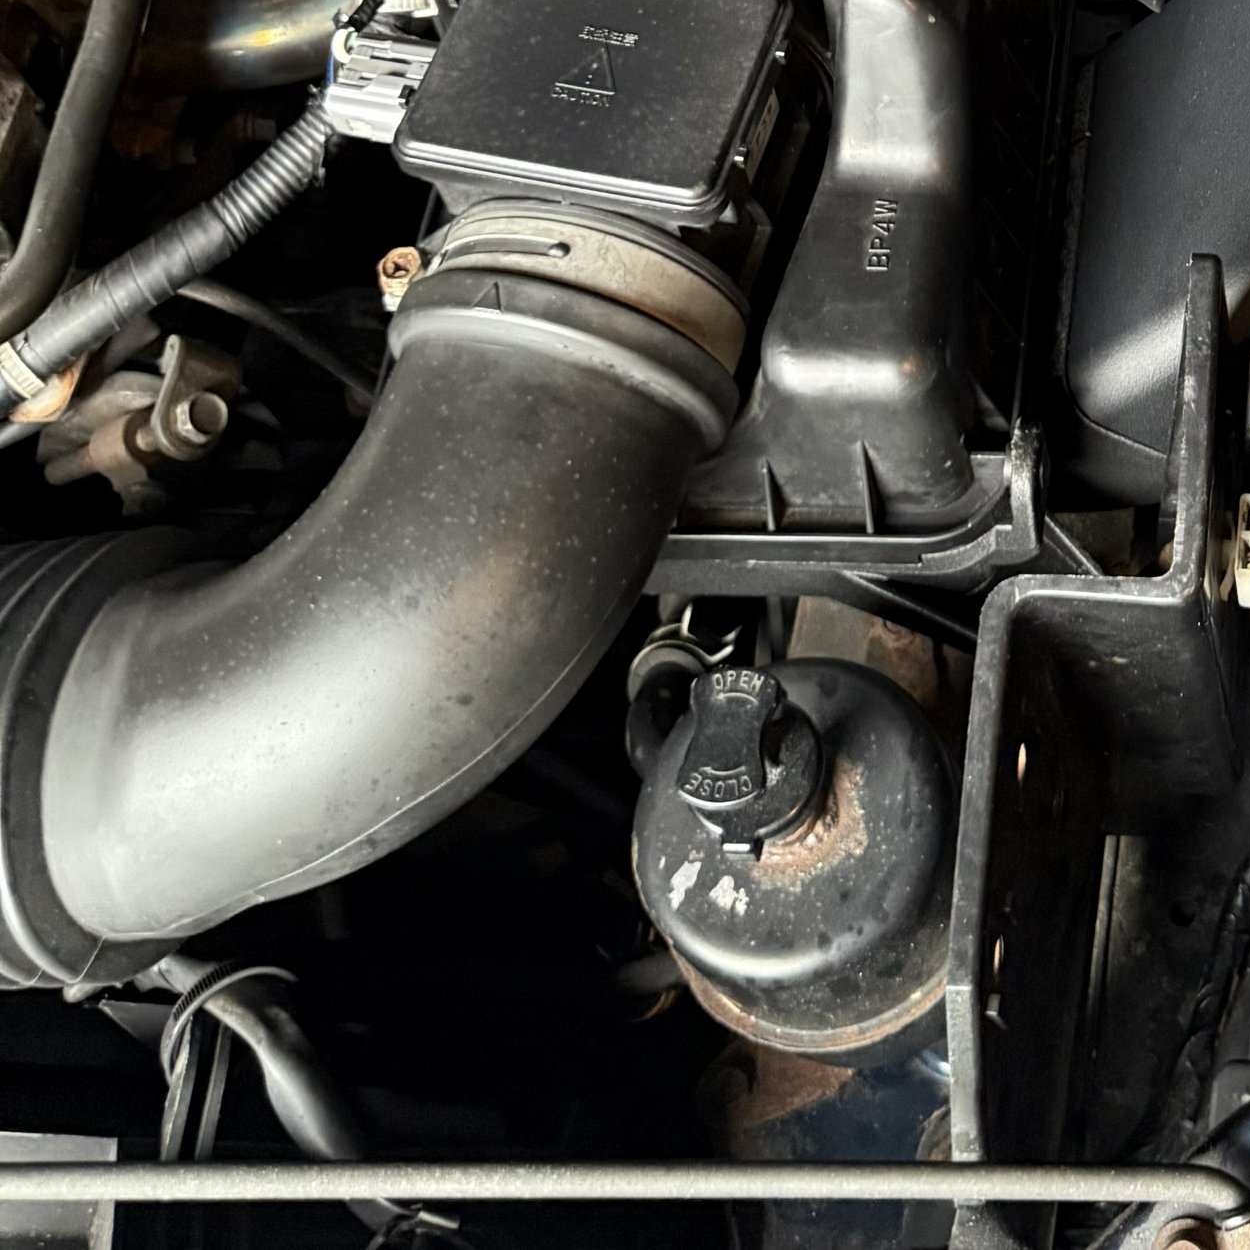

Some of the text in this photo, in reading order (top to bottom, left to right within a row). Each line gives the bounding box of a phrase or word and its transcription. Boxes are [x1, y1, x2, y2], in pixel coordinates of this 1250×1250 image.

[866, 199, 898, 271] BP4W
[712, 669, 765, 693] OPEN
[684, 772, 753, 798] CLOSE
